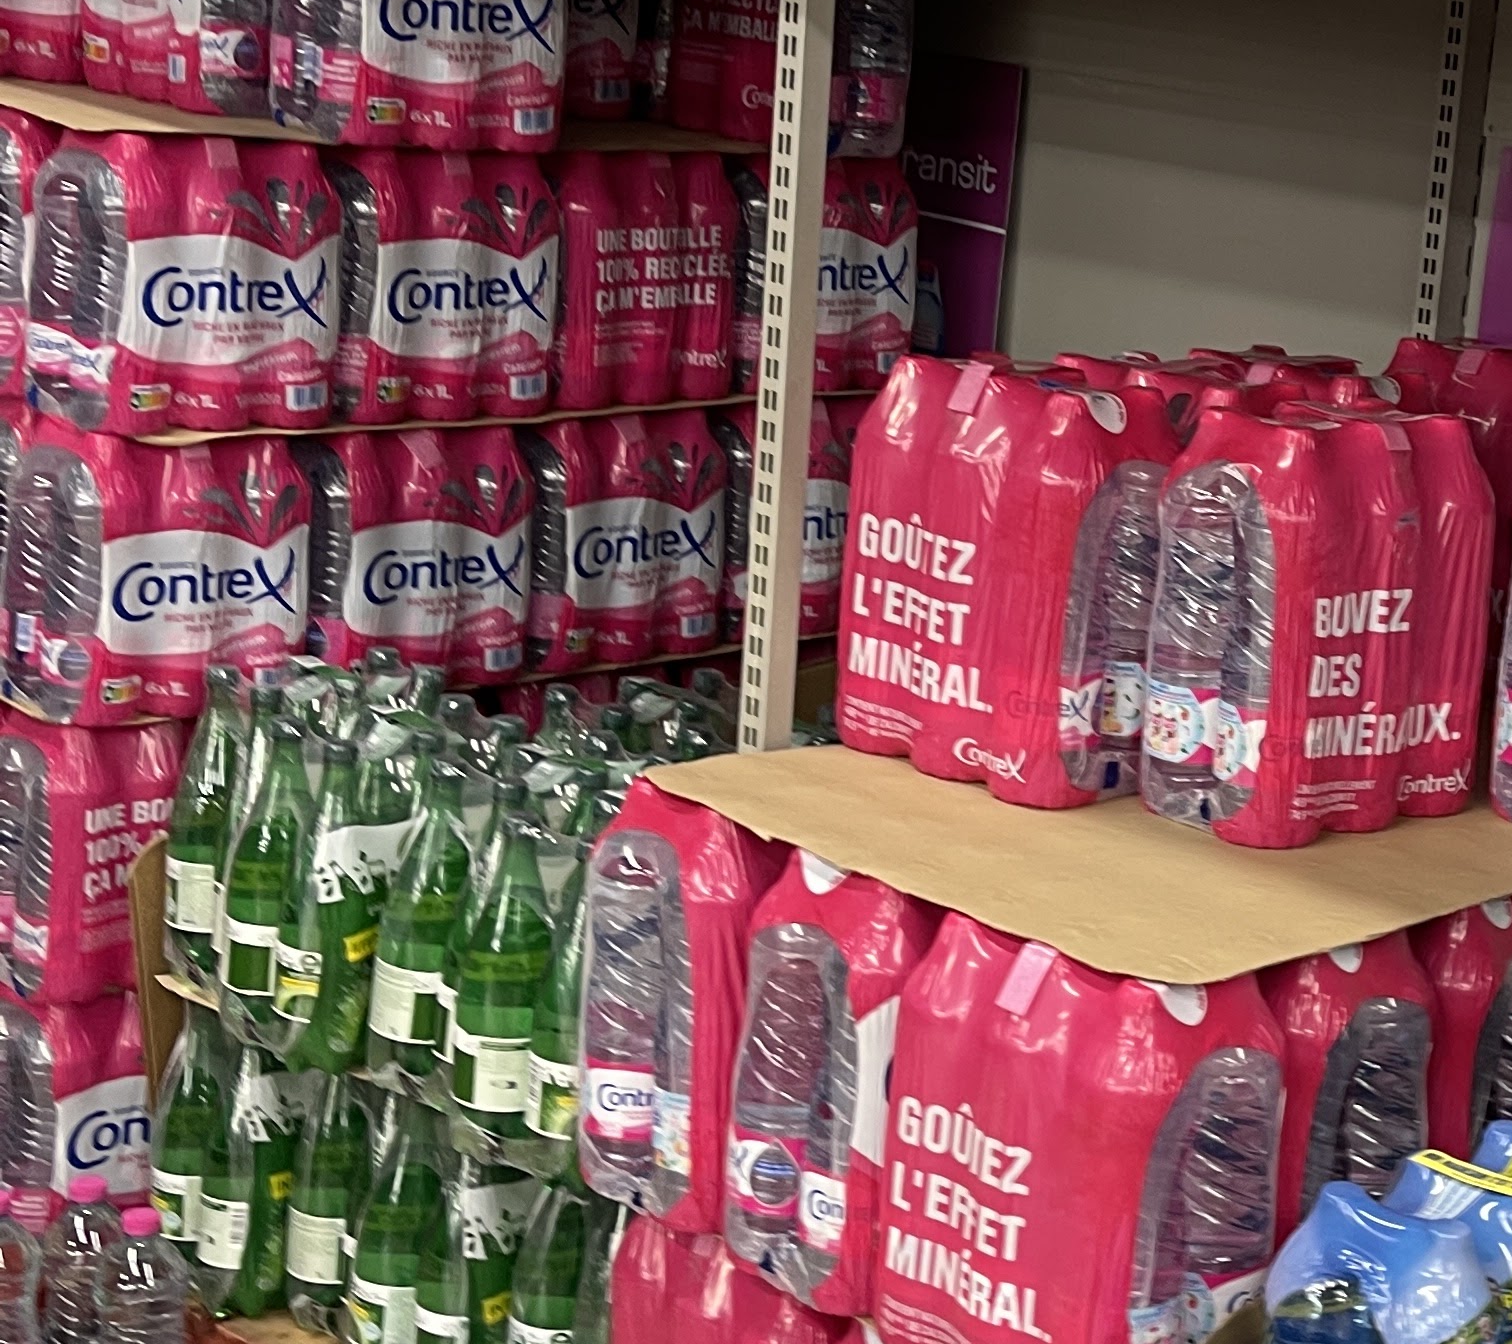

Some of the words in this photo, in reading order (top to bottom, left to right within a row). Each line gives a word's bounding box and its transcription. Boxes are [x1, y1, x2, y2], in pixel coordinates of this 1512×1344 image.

[595, 227, 628, 254] UNE
[858, 512, 977, 586] GOÛTEZ
[1314, 587, 1414, 639] BUVEZ
[847, 631, 994, 713] MINÉRAL.
[1307, 652, 1363, 698] DES
[1304, 700, 1462, 759] MINÉRAUX.
[896, 1095, 1033, 1198] GOÛTEZ
[885, 1225, 1053, 1344] MINÉRAL.
